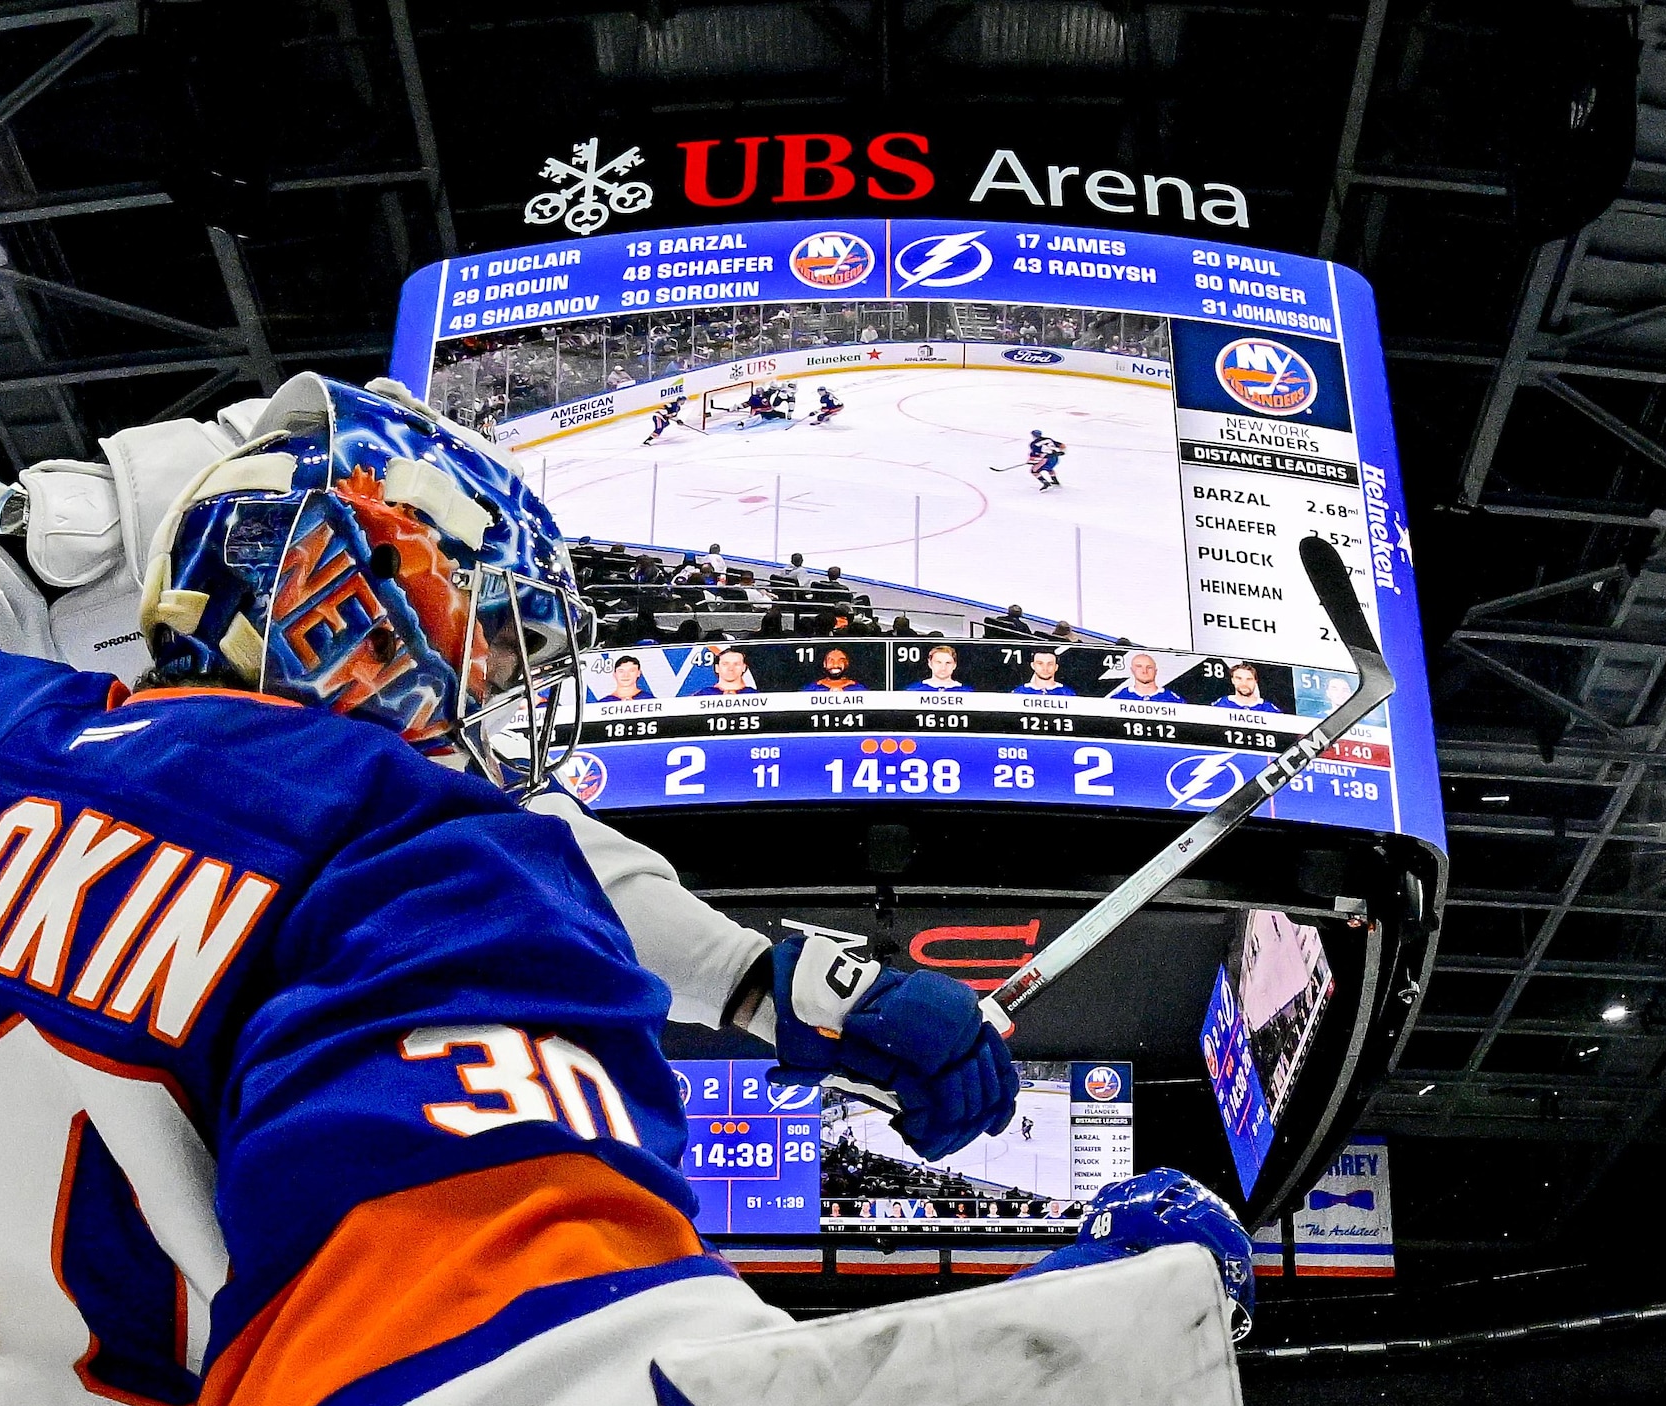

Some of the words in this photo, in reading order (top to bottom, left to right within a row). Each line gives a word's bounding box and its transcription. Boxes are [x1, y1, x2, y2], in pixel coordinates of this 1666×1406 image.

[676, 130, 935, 208] UBS
[969, 148, 1251, 229] Arena
[627, 242, 651, 258] 13
[658, 233, 747, 255] BARZAL
[1016, 233, 1038, 250] 17
[1047, 234, 1126, 257] JAMES
[461, 266, 478, 281] 11
[488, 249, 581, 278] DUCLAIR
[623, 266, 650, 282] 48
[656, 255, 773, 279] SCHAEFER
[1013, 257, 1042, 274] 43
[1049, 259, 1156, 284] RADDYSH
[1192, 249, 1221, 267] 20
[1226, 254, 1281, 277] PAUL
[453, 290, 480, 307] 29
[485, 275, 570, 302] DROUIN
[621, 290, 649, 307] 30
[656, 281, 760, 305] SOROKIN
[1194, 274, 1224, 291] 90
[1229, 277, 1306, 306] MOSER
[449, 314, 477, 331] 49
[482, 295, 600, 328] SHABANOV
[1202, 298, 1228, 317] 31
[1232, 302, 1331, 334] JOHANSSON
[807, 351, 862, 367] Heineken
[1011, 348, 1055, 364] Ford
[746, 359, 777, 377] UBS
[550, 396, 613, 421] AMERICAN
[559, 406, 615, 429] EXPRESS
[1227, 417, 1263, 432] NEW
[1269, 422, 1310, 439] YORK
[1220, 428, 1319, 453] ISLANDERS
[1194, 446, 1272, 468] DISTANCE
[1276, 457, 1348, 480] LEADERS
[1193, 486, 1271, 507] BARZAL
[1195, 515, 1277, 537] SCHAEFER
[1362, 461, 1396, 590] Heineken
[1198, 546, 1274, 568] PULOCK
[1200, 578, 1283, 601] HEINEMAN
[1203, 613, 1276, 634] PELECH
[691, 650, 714, 667] 49
[796, 648, 814, 664] 11
[897, 647, 920, 663] 90
[1001, 650, 1022, 666] 71
[1102, 653, 1126, 671] 43
[591, 658, 614, 674] 48
[1203, 662, 1225, 679] 38
[1302, 673, 1320, 691] 51
[600, 702, 662, 716] SCHAEFER
[699, 697, 768, 710] SHABANOV
[810, 695, 864, 706] DUCLAIR
[920, 695, 963, 706] MOSER
[1023, 698, 1068, 710] CIRELLI
[1120, 704, 1177, 716] RADDYSH
[605, 720, 658, 738] 18:36
[707, 716, 761, 732] 10:35
[810, 713, 865, 728] 11:41
[915, 713, 970, 728] 16:01
[1019, 716, 1074, 732] 12:13
[1229, 713, 1268, 726] HAGEL
[1122, 722, 1176, 739] 18:12
[1225, 730, 1277, 749] 12:38
[750, 747, 780, 760] SOG
[997, 747, 1028, 760] SOG
[1256, 727, 1332, 796] CCM
[665, 746, 706, 796] 2
[753, 764, 780, 789] 11
[824, 758, 962, 793] 14:38
[993, 764, 1035, 789] 26
[1073, 747, 1114, 796] 2
[1305, 761, 1357, 778] PENALTY
[1290, 773, 1314, 793] 51
[1330, 779, 1379, 801] 1:39
[1007, 976, 1046, 1012] COMPOSITE
[399, 1023, 643, 1149] 30
[704, 1078, 719, 1099] 2
[742, 1078, 759, 1099] 2
[787, 1124, 810, 1135] SOG
[691, 1143, 773, 1167] 14:38
[784, 1142, 816, 1162] 26
[747, 1196, 762, 1209] 51
[1090, 1212, 1112, 1239] 48
